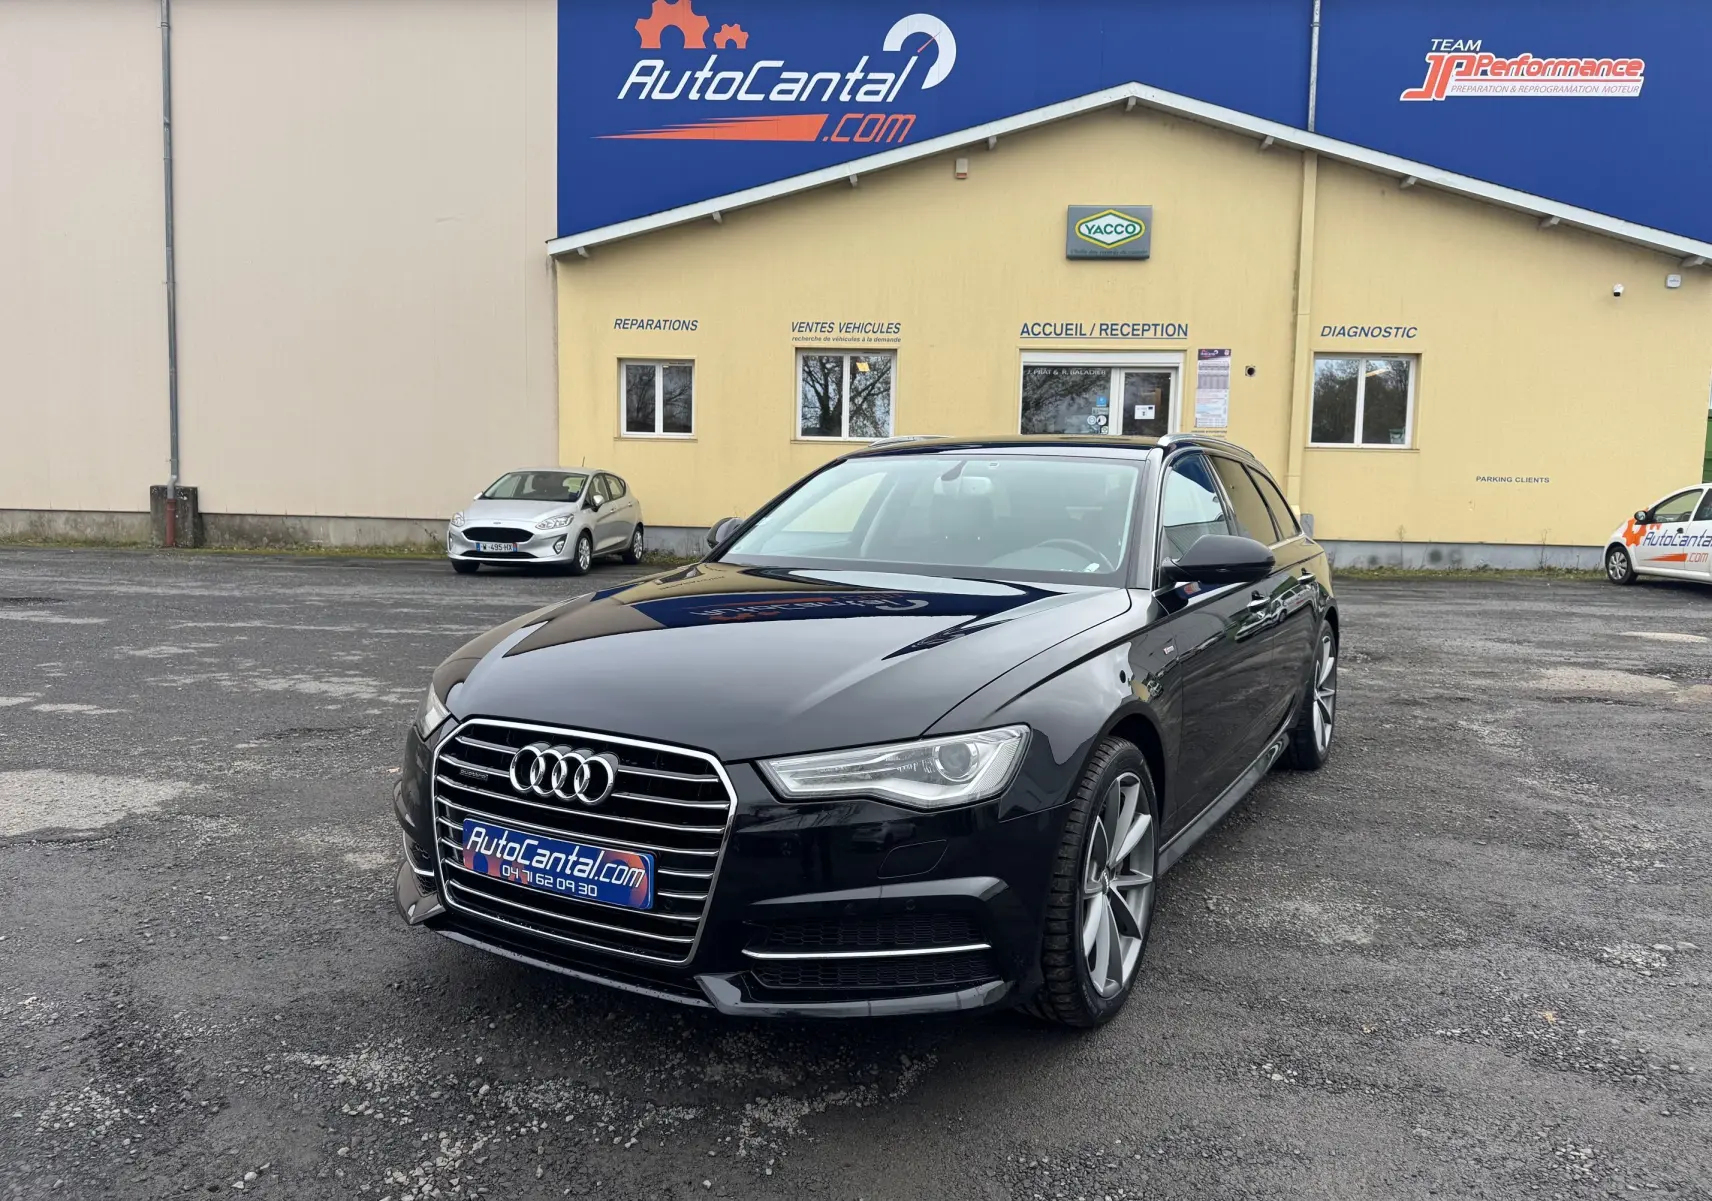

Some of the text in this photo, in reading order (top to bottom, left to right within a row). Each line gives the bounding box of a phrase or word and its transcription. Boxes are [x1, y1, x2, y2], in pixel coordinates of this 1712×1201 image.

[1431, 39, 1482, 51] TEAM
[617, 54, 918, 102] AutoCantal
[1451, 85, 1640, 94] PREPARATION & REPROGRAMATION MOTEUR
[1085, 223, 1137, 235] YACCO
[613, 318, 698, 332] REPARATIONS
[791, 321, 901, 334] VENTES VEHICULES
[1020, 322, 1088, 337] ACCUEIL
[1099, 323, 1188, 337] RECEPTION
[1320, 325, 1418, 339] DIAGNOSTIC
[1475, 475, 1550, 484] PARKING CLIENTS
[1643, 529, 1712, 547] AutoCanta
[467, 827, 646, 888] AutoCantal.com
[502, 864, 597, 897] 04 71 62 09 30
